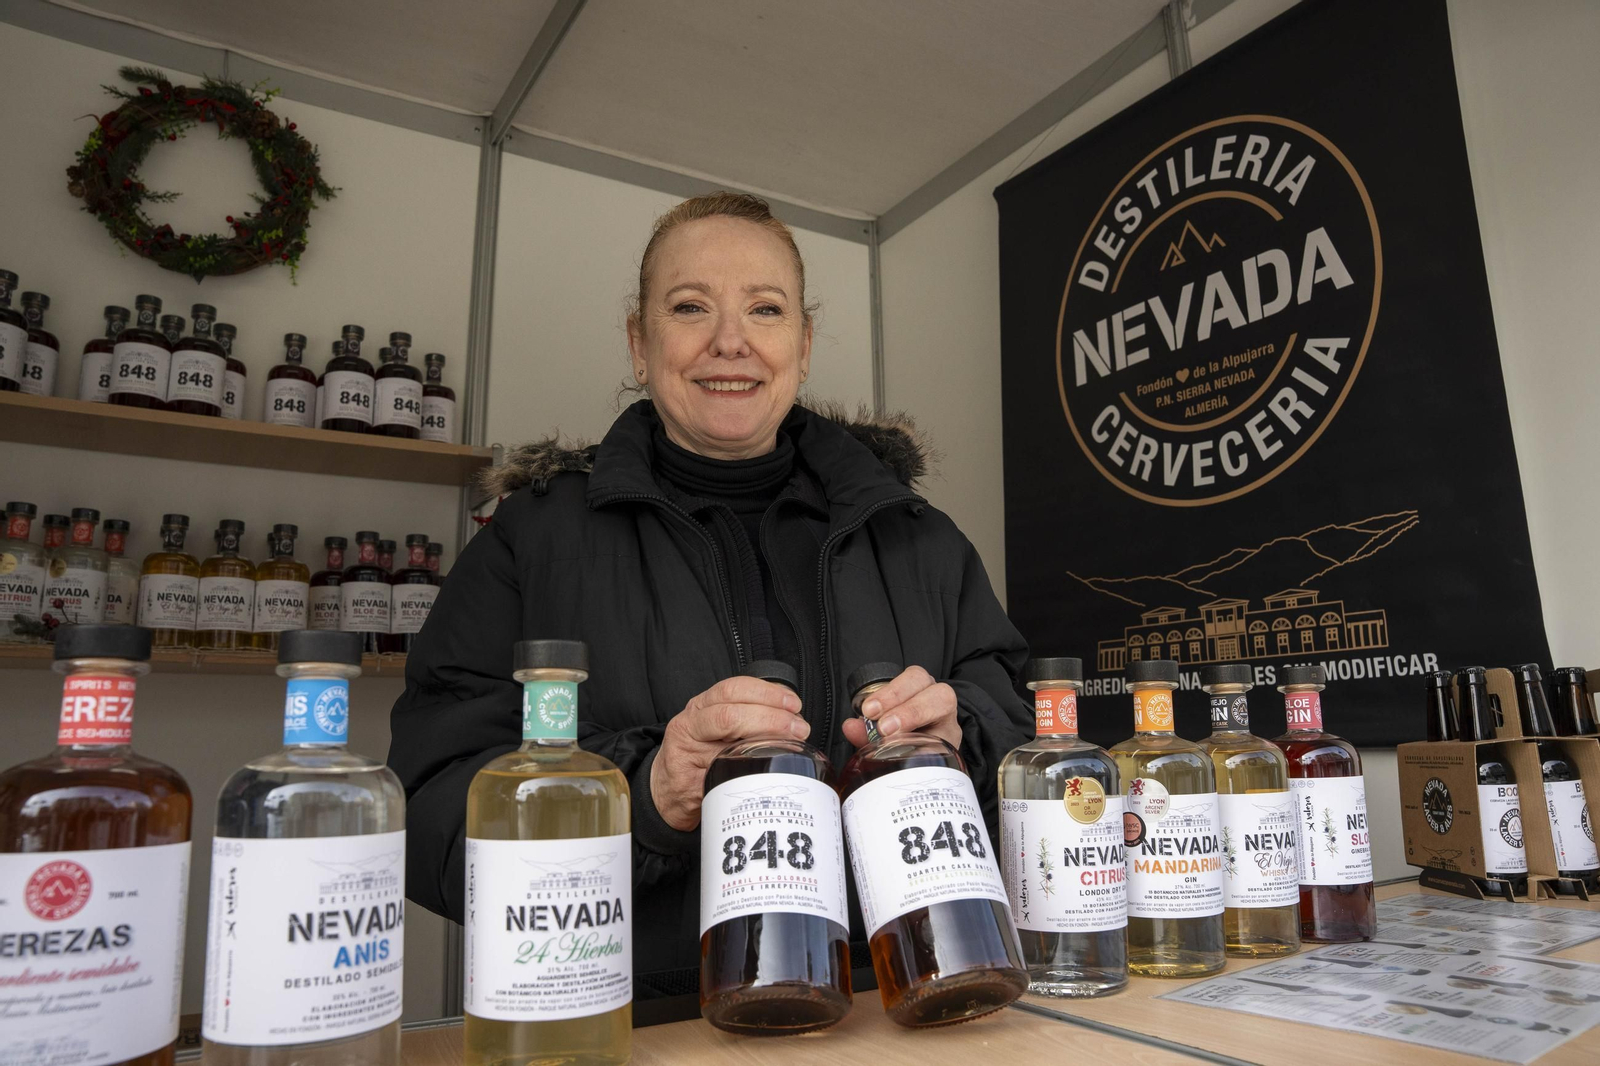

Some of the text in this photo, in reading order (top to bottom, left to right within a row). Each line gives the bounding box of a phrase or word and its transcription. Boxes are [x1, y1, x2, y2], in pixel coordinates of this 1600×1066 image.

[1078, 134, 1316, 292] DESTILERIA
[1073, 226, 1355, 387] NEVADA
[119, 364, 157, 381] 848
[1136, 343, 1275, 397] Fondón de la Alpujarra
[178, 371, 214, 388] 848
[1155, 367, 1256, 409] P.N. SIERRA NEVADA
[273, 398, 306, 413] 848
[340, 391, 370, 408] 848
[393, 397, 420, 415] 848
[1184, 394, 1229, 418] ALMERÍA
[1091, 337, 1351, 487] CERVECERIA
[46, 587, 90, 598] NEVADA
[157, 593, 196, 604] NEVADA
[204, 595, 245, 605] NEVADA
[265, 598, 304, 608] NEVADA
[352, 600, 389, 609] NEVADA
[1320, 652, 1440, 682] MODIFICAR
[542, 687, 573, 701] NEVADA
[1285, 699, 1310, 709] SLOE
[538, 703, 556, 727] CRAFT
[1040, 718, 1053, 727] GIN
[1286, 709, 1311, 723] GIN
[1424, 779, 1448, 797] NEVADA
[780, 810, 814, 819] NEVADA
[950, 801, 975, 811] NEVADA
[722, 820, 751, 832] WHISKY
[787, 818, 814, 827] MALTA
[893, 811, 926, 824] WHISKY
[958, 809, 977, 819] MALTA
[1423, 803, 1439, 831] LAGER
[1444, 805, 1453, 830] ALES
[898, 821, 986, 865] 848
[1141, 834, 1219, 856] NEVADA
[1500, 827, 1518, 847] LAGER
[722, 830, 814, 875] 848
[1254, 852, 1273, 870] El
[907, 865, 946, 879] QUARTER
[722, 878, 752, 889] BARRIL
[760, 883, 818, 892] IRREPETIBLE
[1080, 887, 1110, 896] LONDON
[506, 897, 624, 931] NEVADA
[514, 931, 623, 964] 24 Hierbas
[284, 971, 362, 989] DESTILADO
